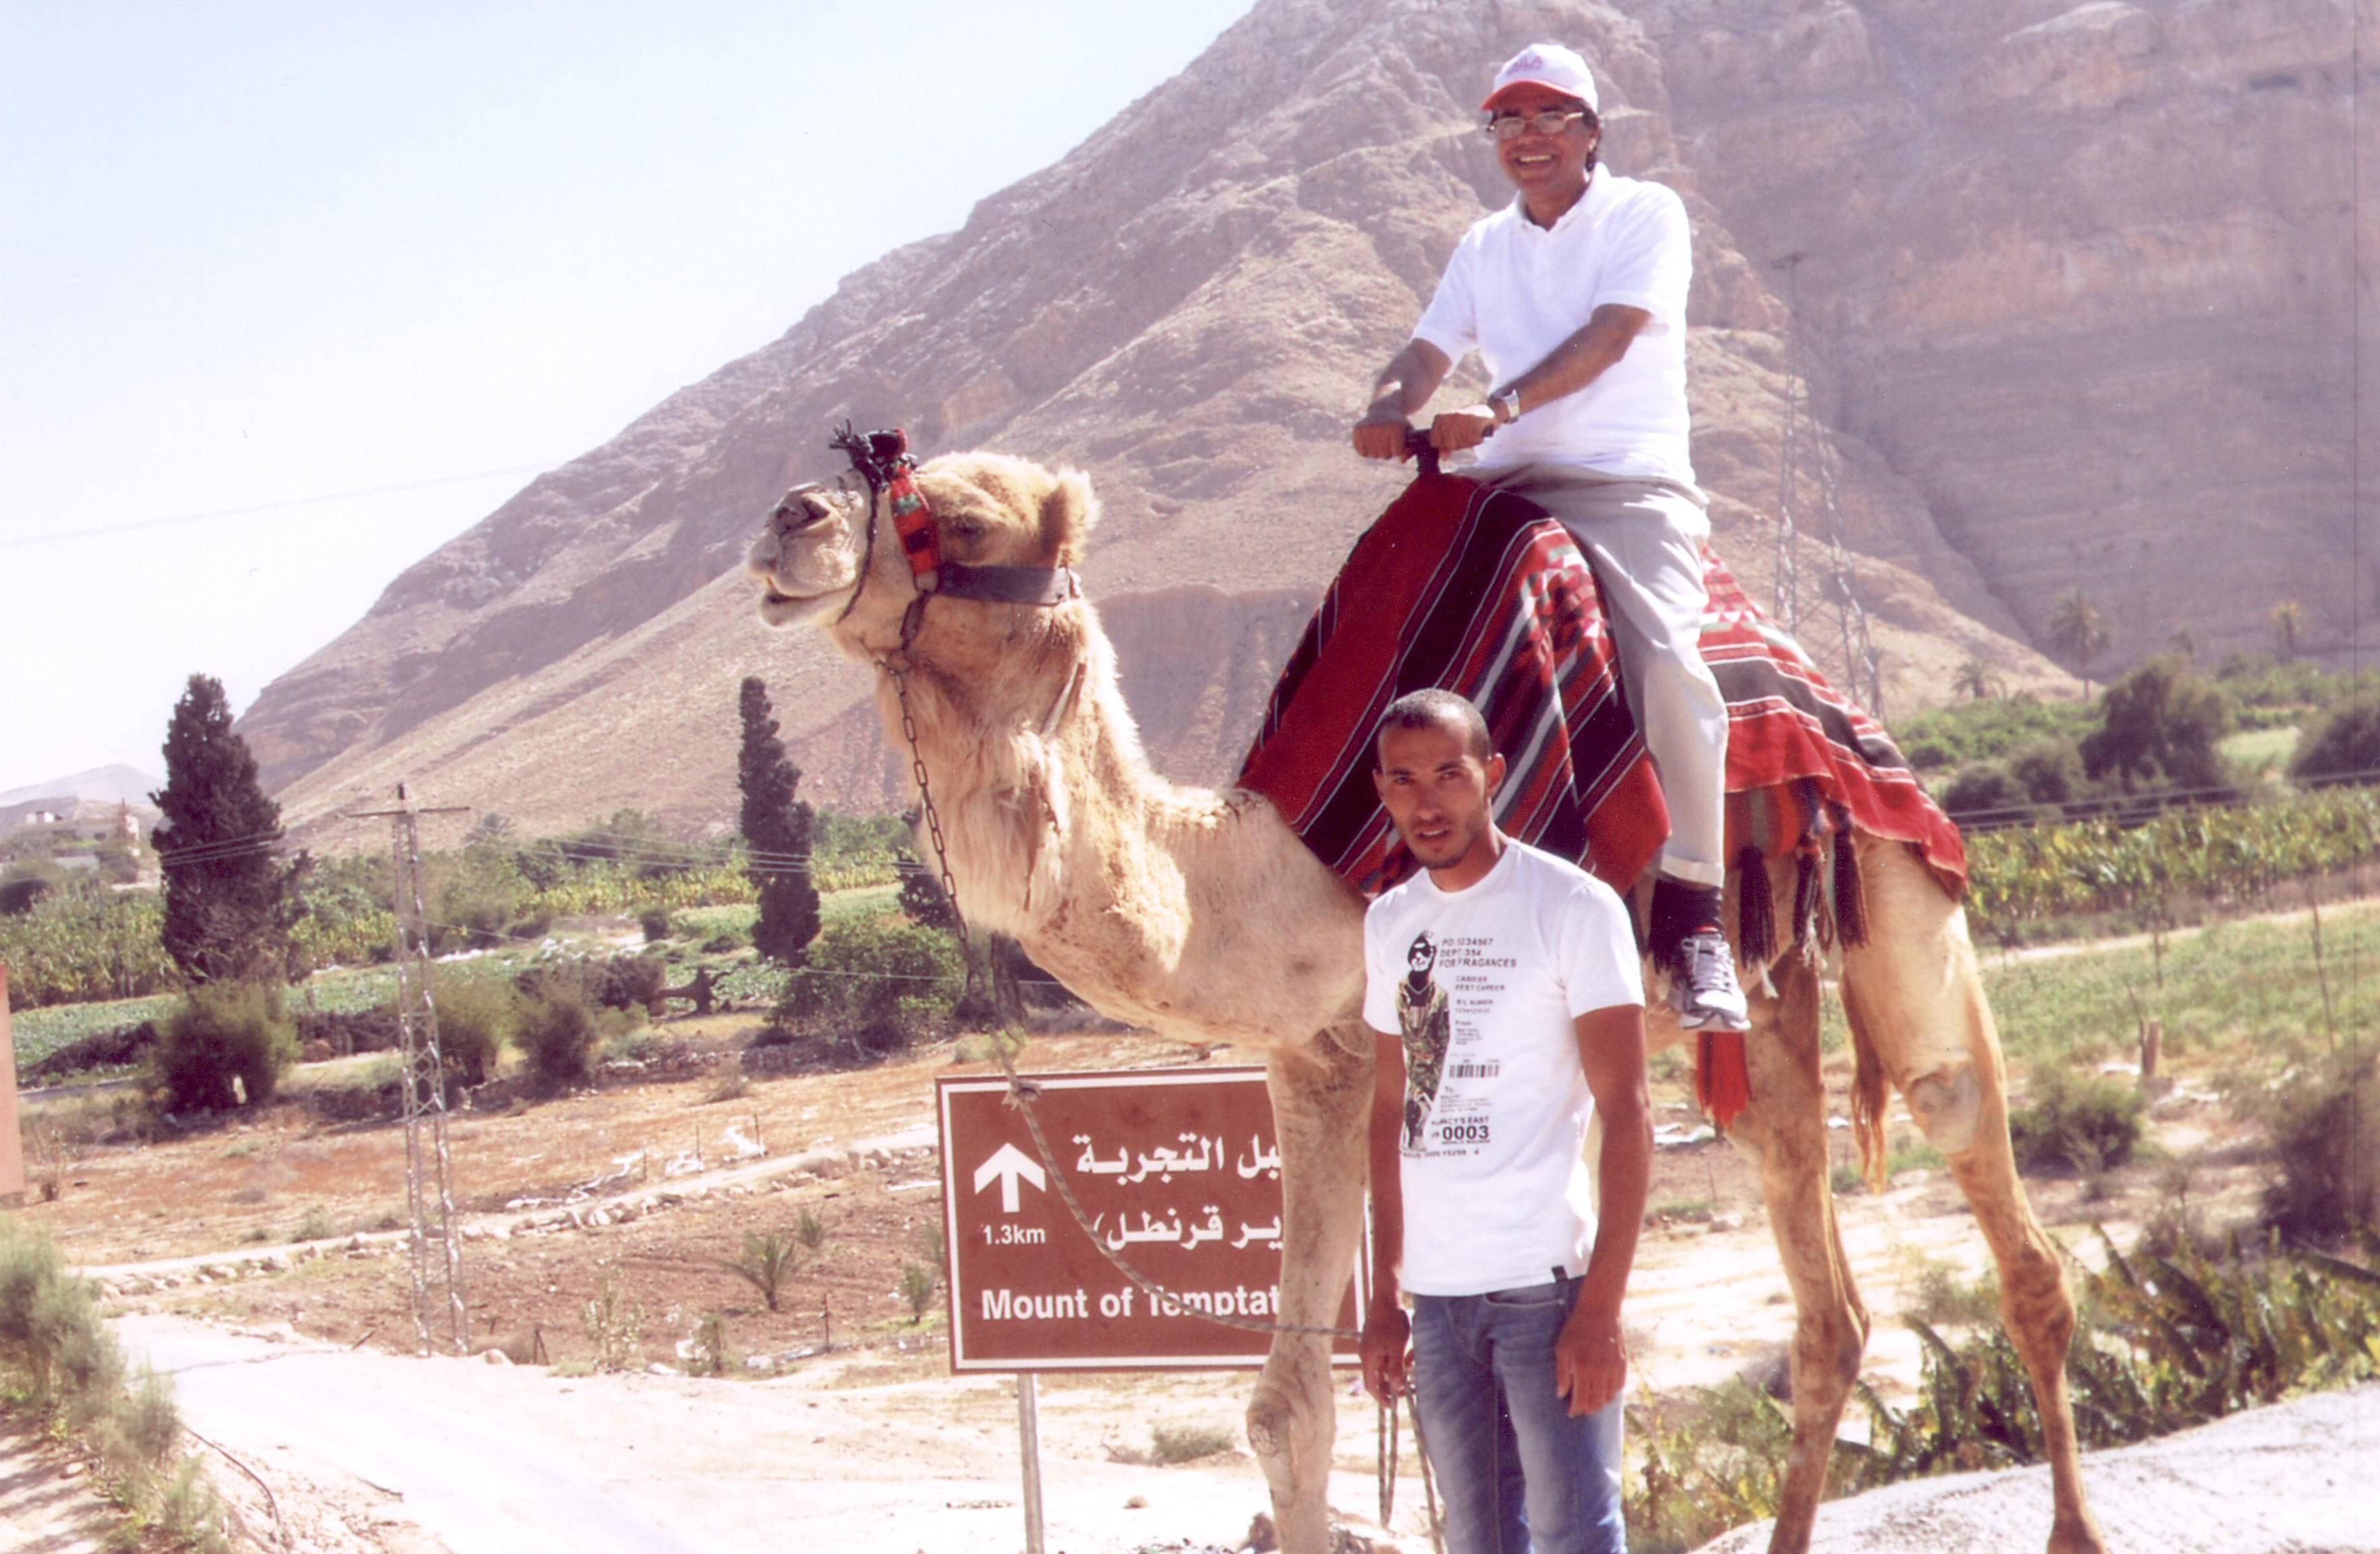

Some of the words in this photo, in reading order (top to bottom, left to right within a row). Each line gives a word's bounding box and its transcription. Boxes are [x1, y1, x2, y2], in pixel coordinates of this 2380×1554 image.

[1442, 1125, 1490, 1141] 0003
[1467, 1116, 1490, 1124] EAST
[1073, 1133, 1224, 1185] التجربة
[1237, 1128, 1284, 1180] بل
[984, 1224, 1046, 1245] 1.3km
[1230, 1215, 1284, 1250] ير
[982, 1288, 1088, 1320] Mount
[1100, 1286, 1133, 1318] of
[1143, 1285, 1281, 1317] Temptat
